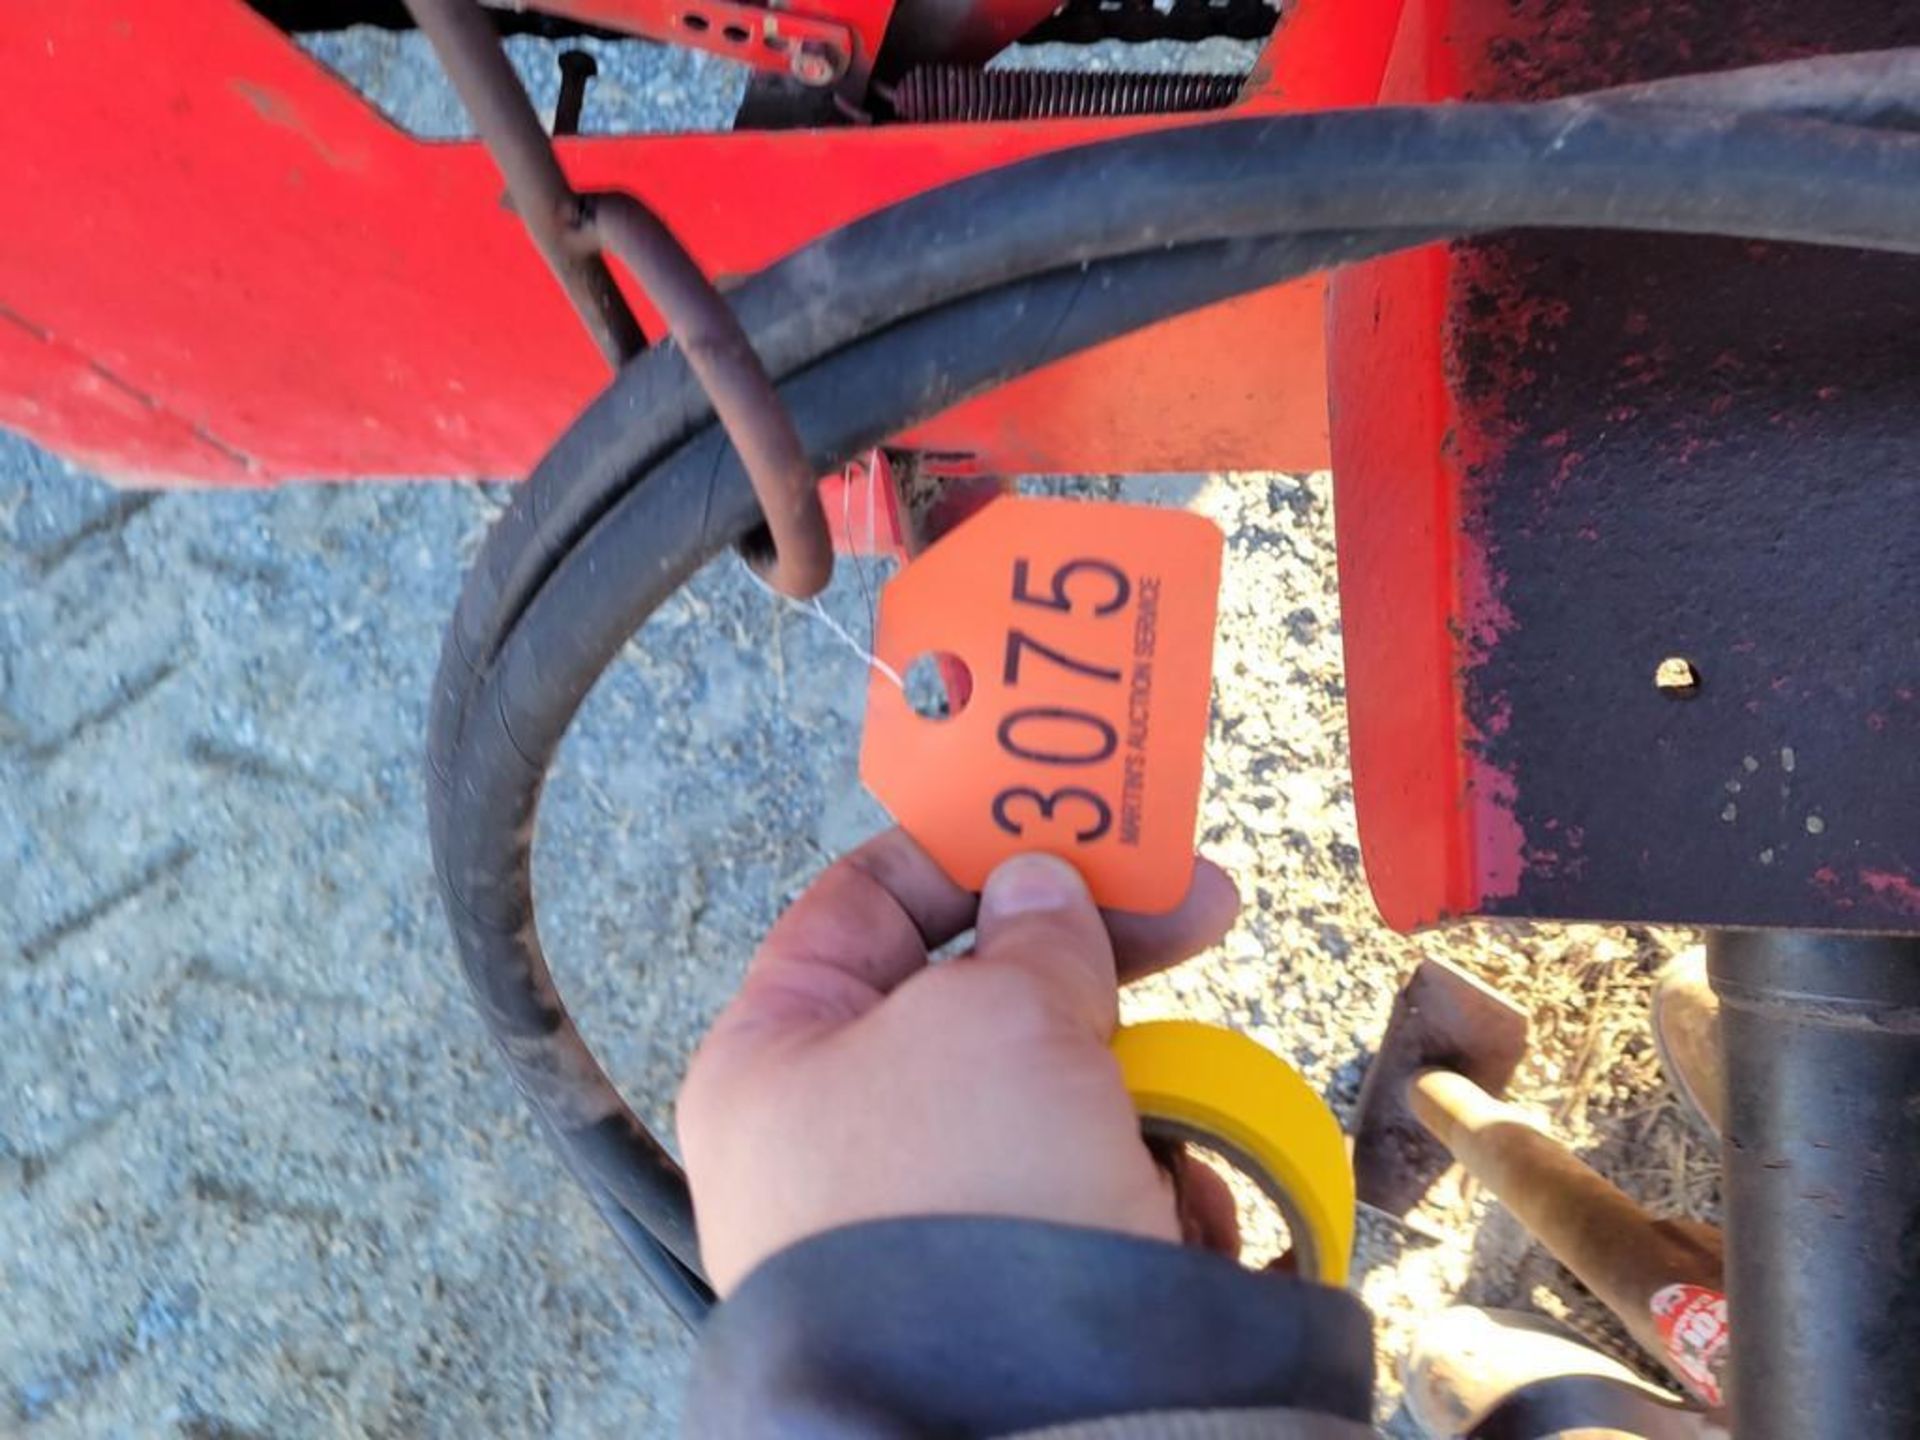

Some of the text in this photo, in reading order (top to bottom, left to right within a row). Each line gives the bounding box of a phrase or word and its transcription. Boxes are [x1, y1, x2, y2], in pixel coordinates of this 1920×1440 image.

[991, 557, 1131, 845] 3075
[1119, 575, 1160, 846] MARTIN'S AUCTION SERVICE
